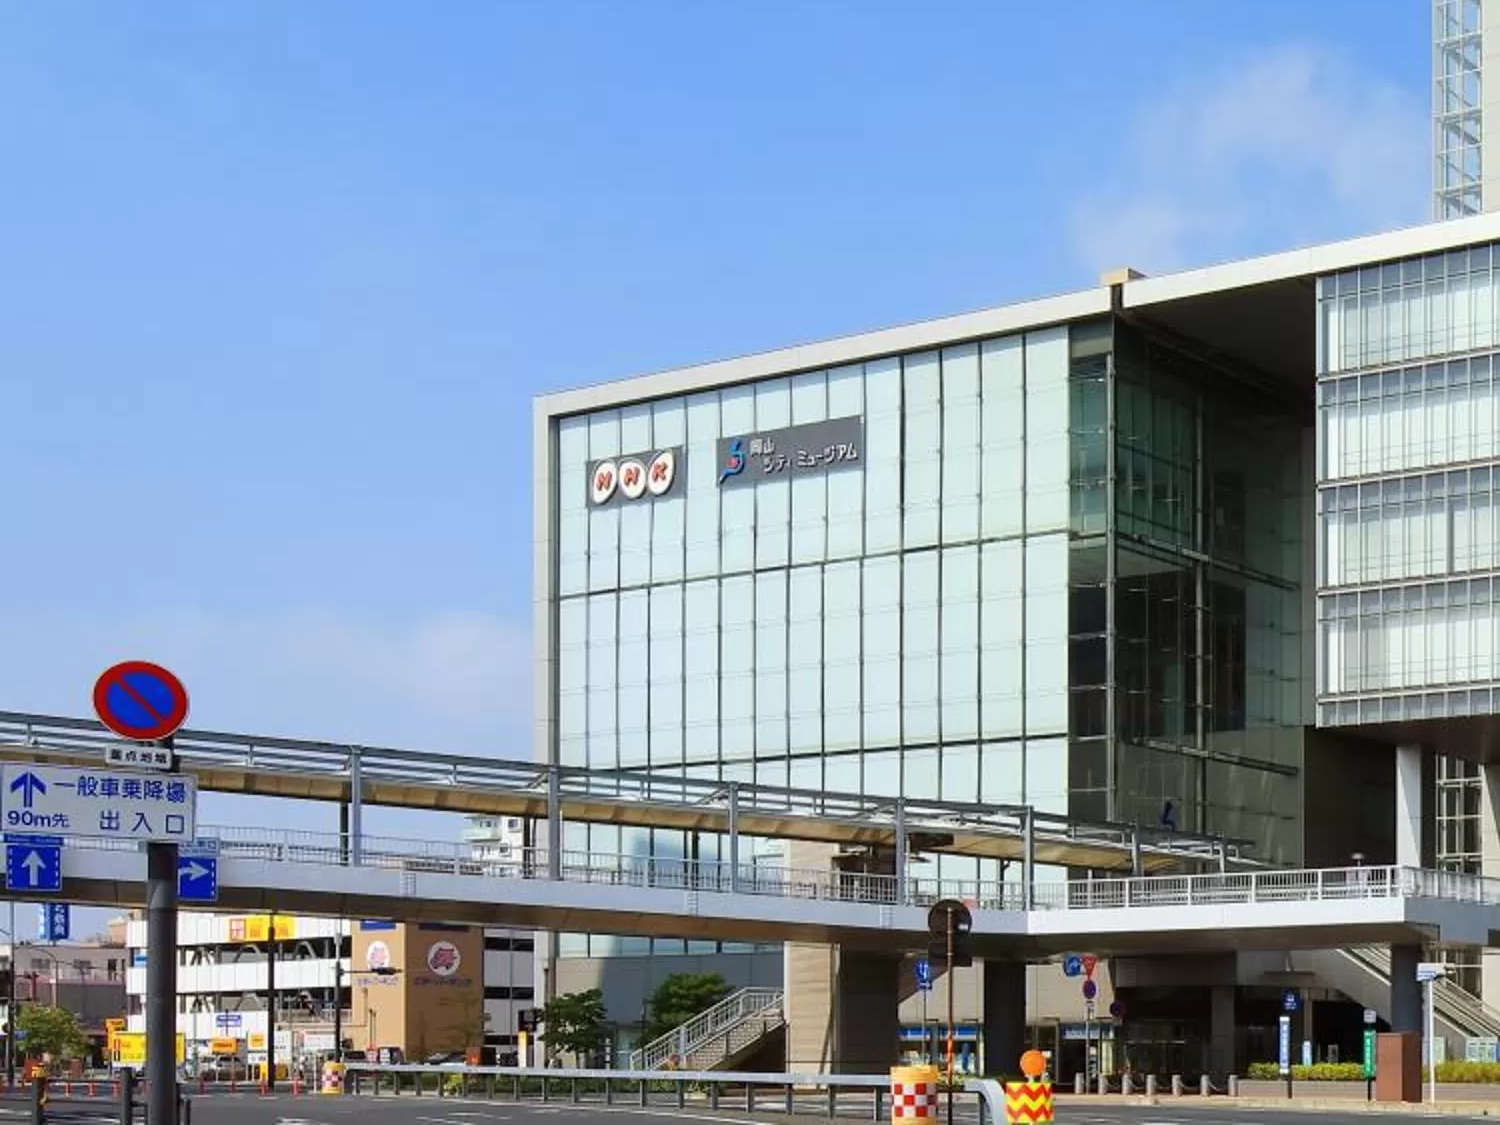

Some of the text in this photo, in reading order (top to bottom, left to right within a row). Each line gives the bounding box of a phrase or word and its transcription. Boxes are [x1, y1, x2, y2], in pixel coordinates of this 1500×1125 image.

[750, 438, 775, 457] 岡山
[594, 458, 670, 494] NHK
[53, 775, 187, 804] 一般車乗降場
[7, 810, 70, 828] 90m先
